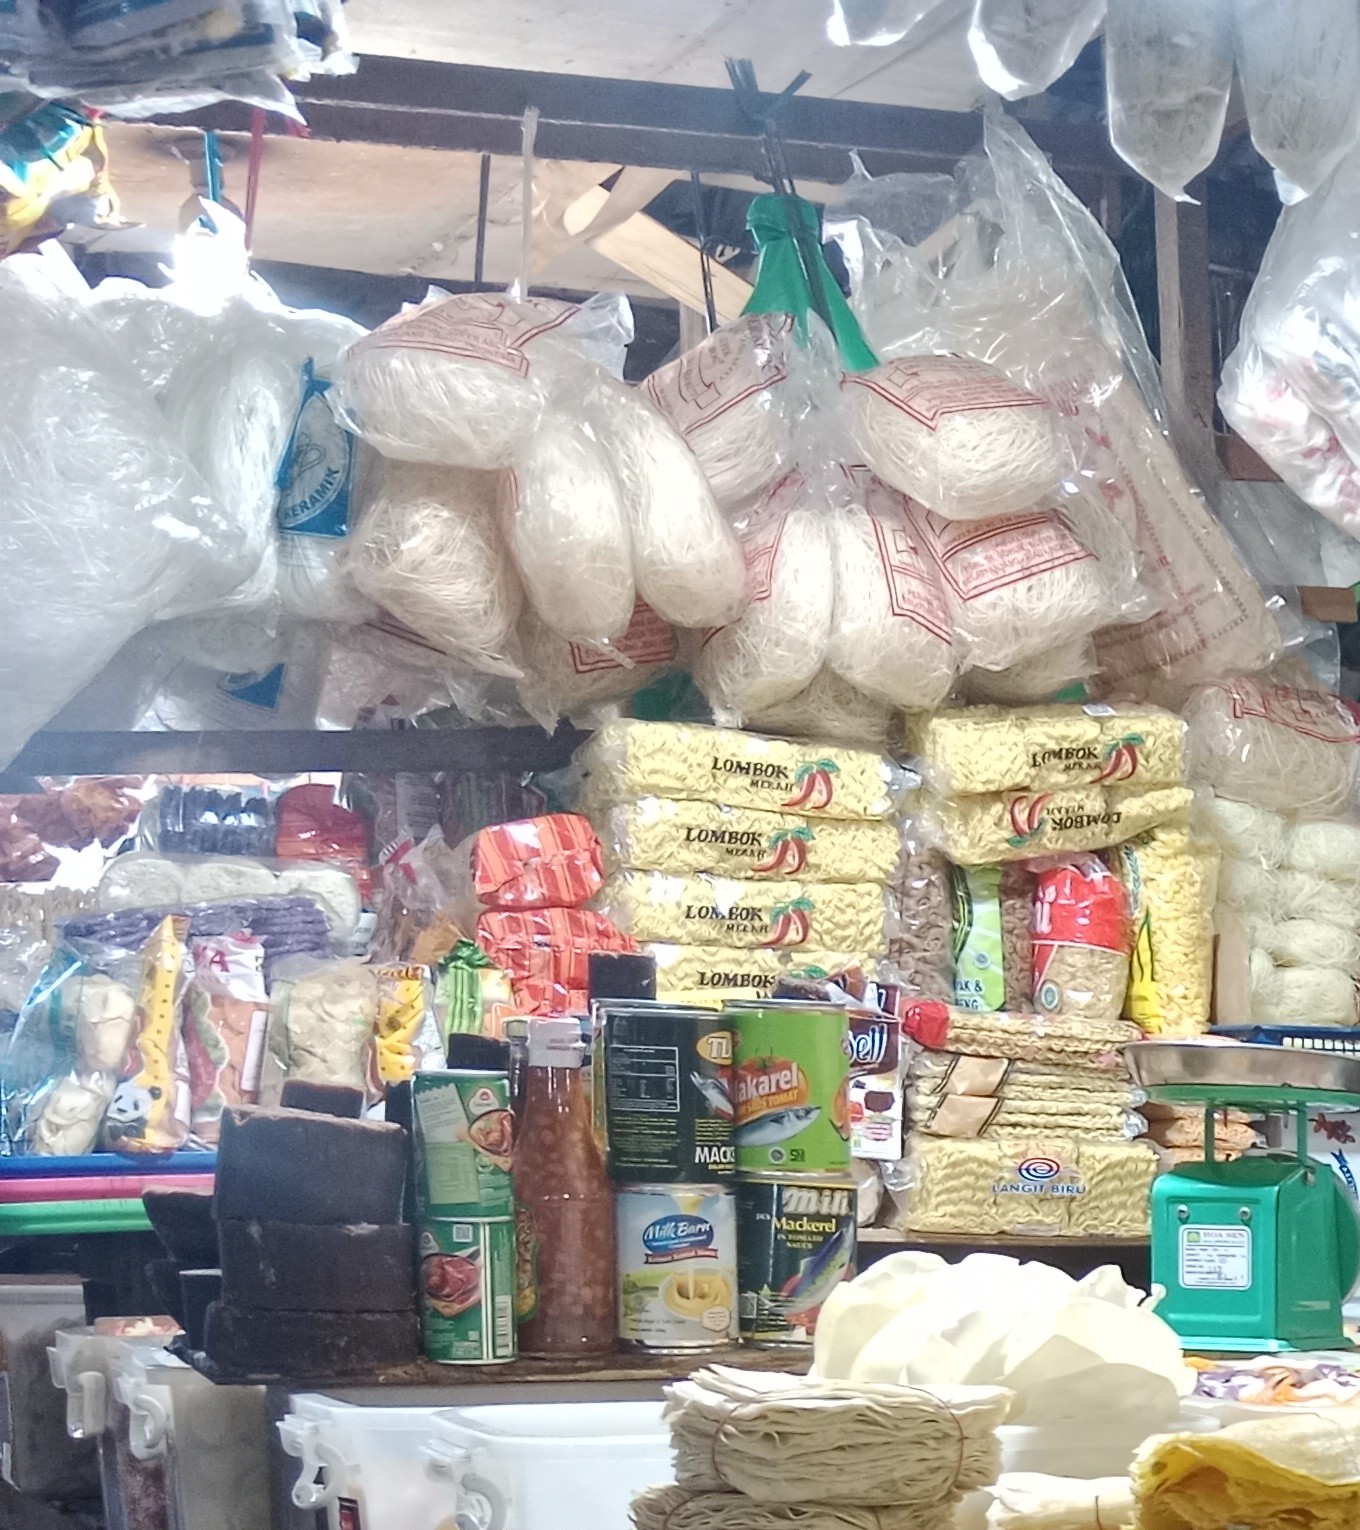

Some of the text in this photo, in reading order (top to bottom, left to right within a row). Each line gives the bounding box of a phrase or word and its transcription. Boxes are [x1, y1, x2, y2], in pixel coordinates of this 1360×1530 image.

[1031, 747, 1100, 768] LOMBOK
[711, 756, 790, 779] LOMBOK
[1051, 812, 1122, 831] LOMBOK
[685, 828, 764, 847] LOMBOK
[699, 971, 776, 989] LOMBOK
[991, 1182, 1086, 1195] LANGIT BIRU
[773, 1216, 837, 1233] Mackerel
